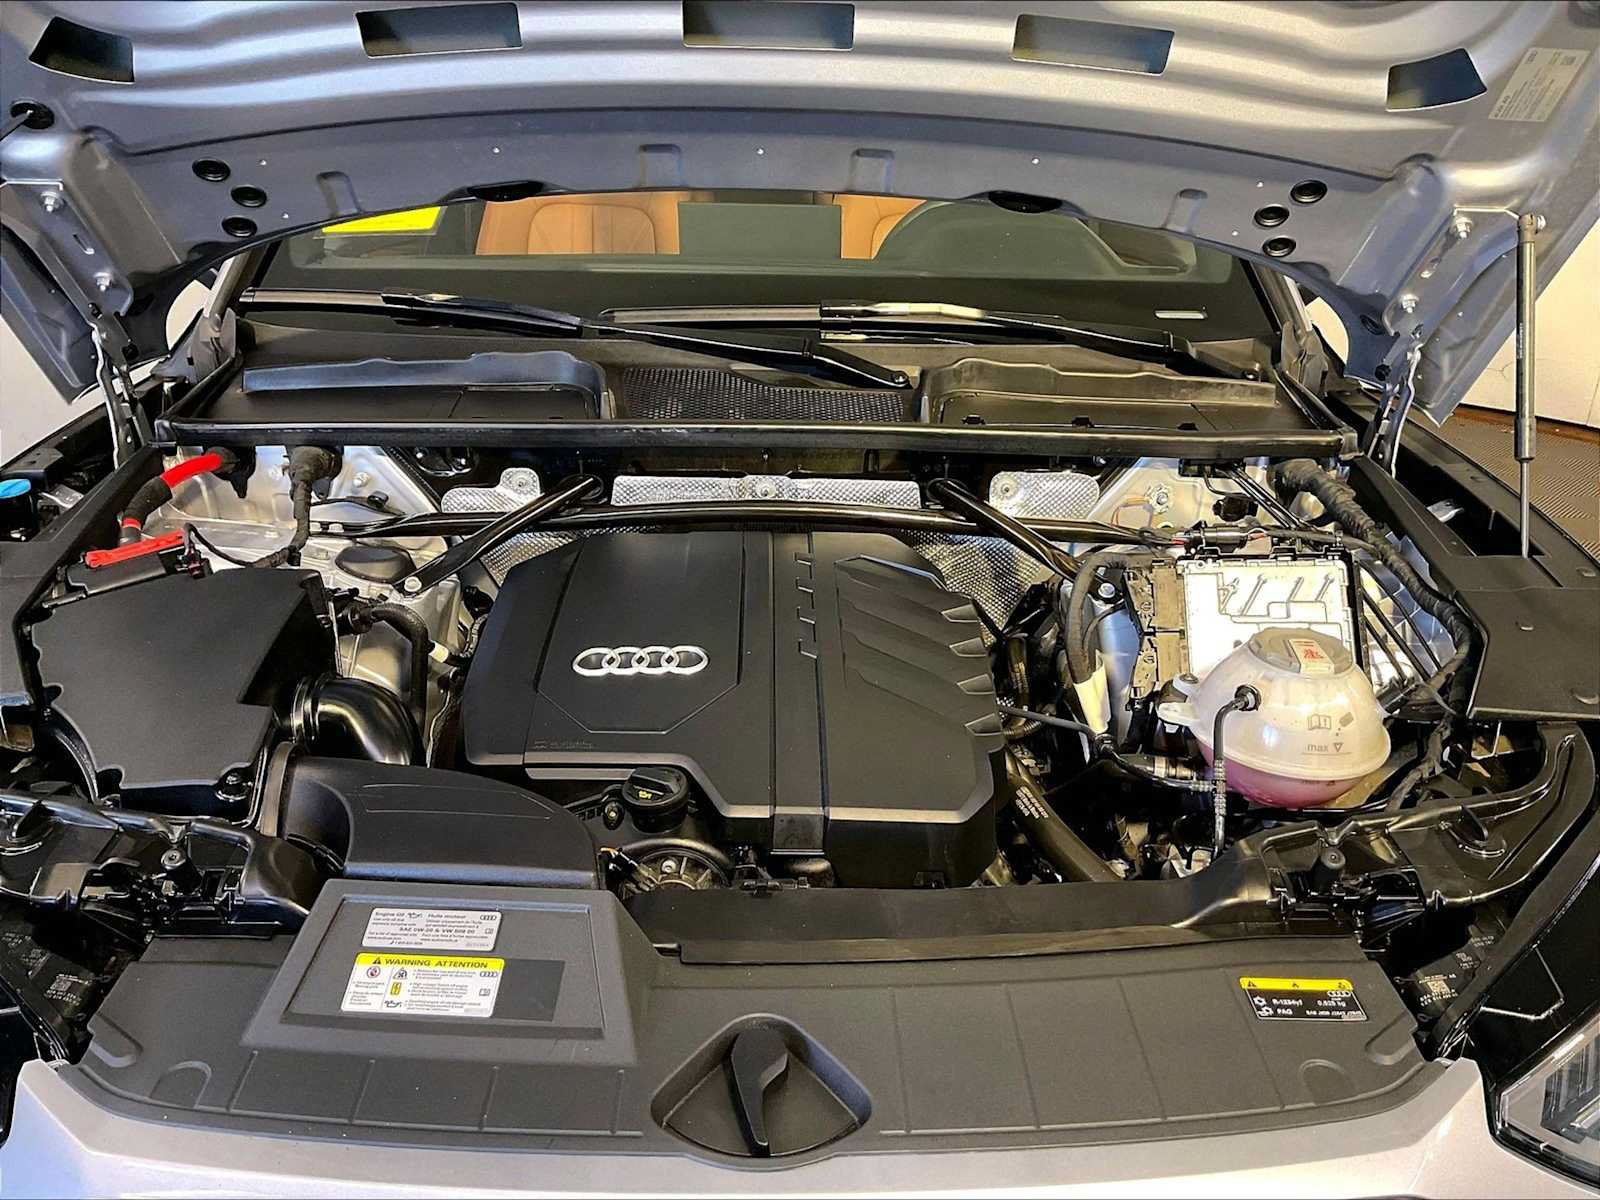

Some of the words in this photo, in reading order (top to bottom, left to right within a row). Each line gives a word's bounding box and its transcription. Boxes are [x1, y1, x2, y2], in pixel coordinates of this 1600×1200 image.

[1307, 743, 1329, 752] max
[384, 958, 431, 967] WARNING
[434, 960, 488, 968] ATTENTION
